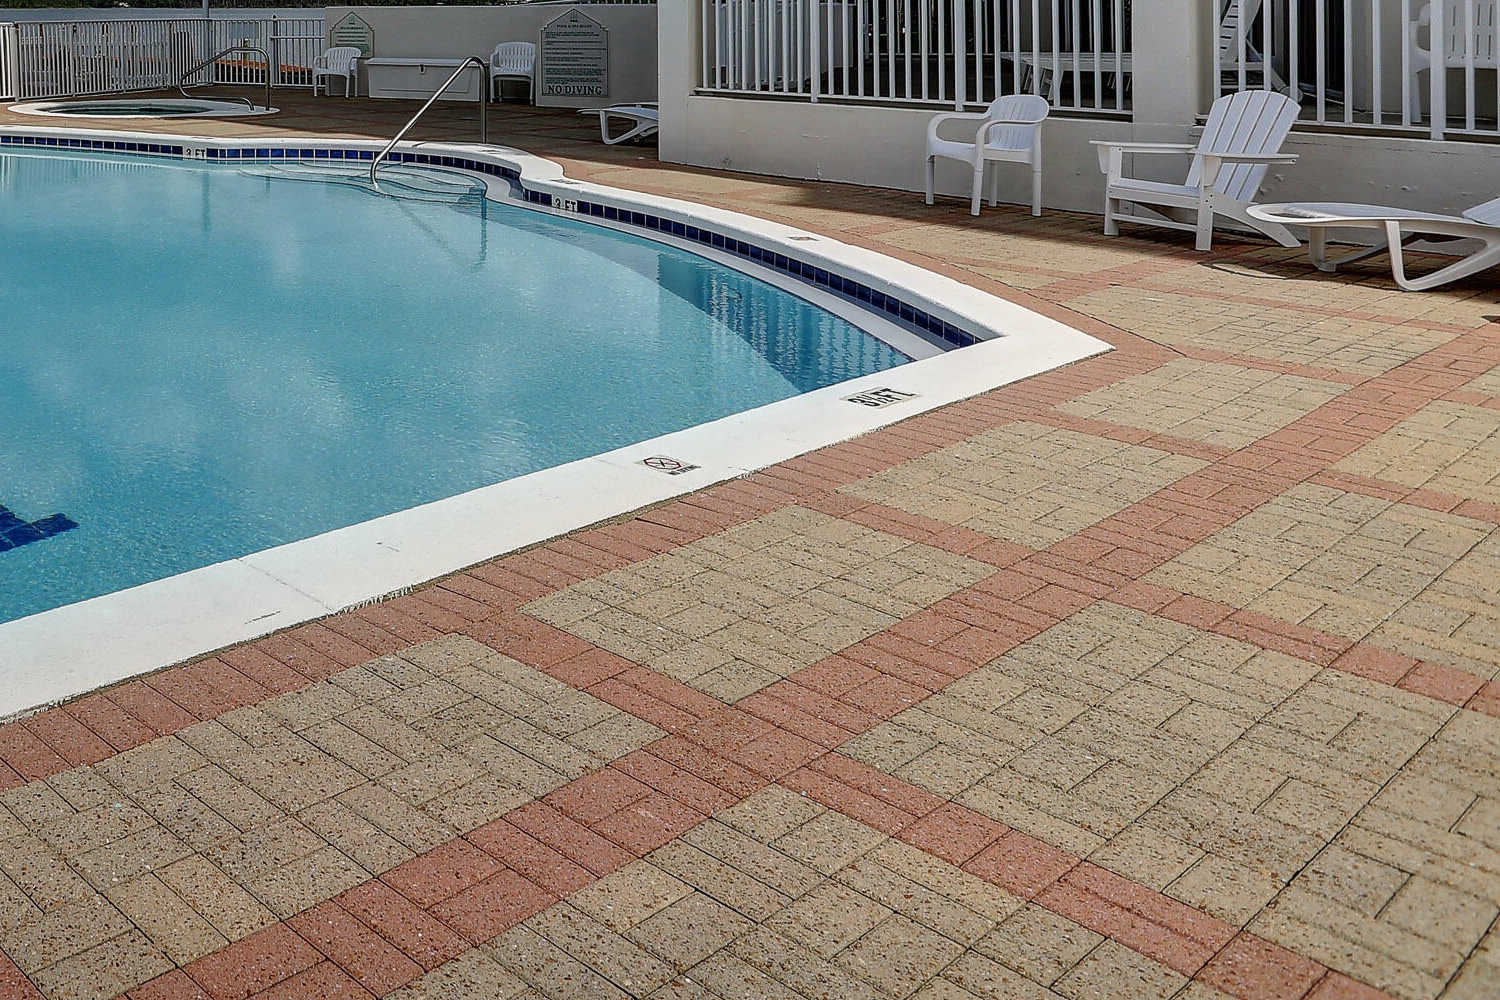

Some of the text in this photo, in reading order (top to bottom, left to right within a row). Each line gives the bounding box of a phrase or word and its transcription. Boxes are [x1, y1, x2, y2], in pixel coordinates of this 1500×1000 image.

[548, 84, 602, 95] NO DIVING
[186, 148, 206, 157] 3 FT
[565, 200, 576, 212] FT
